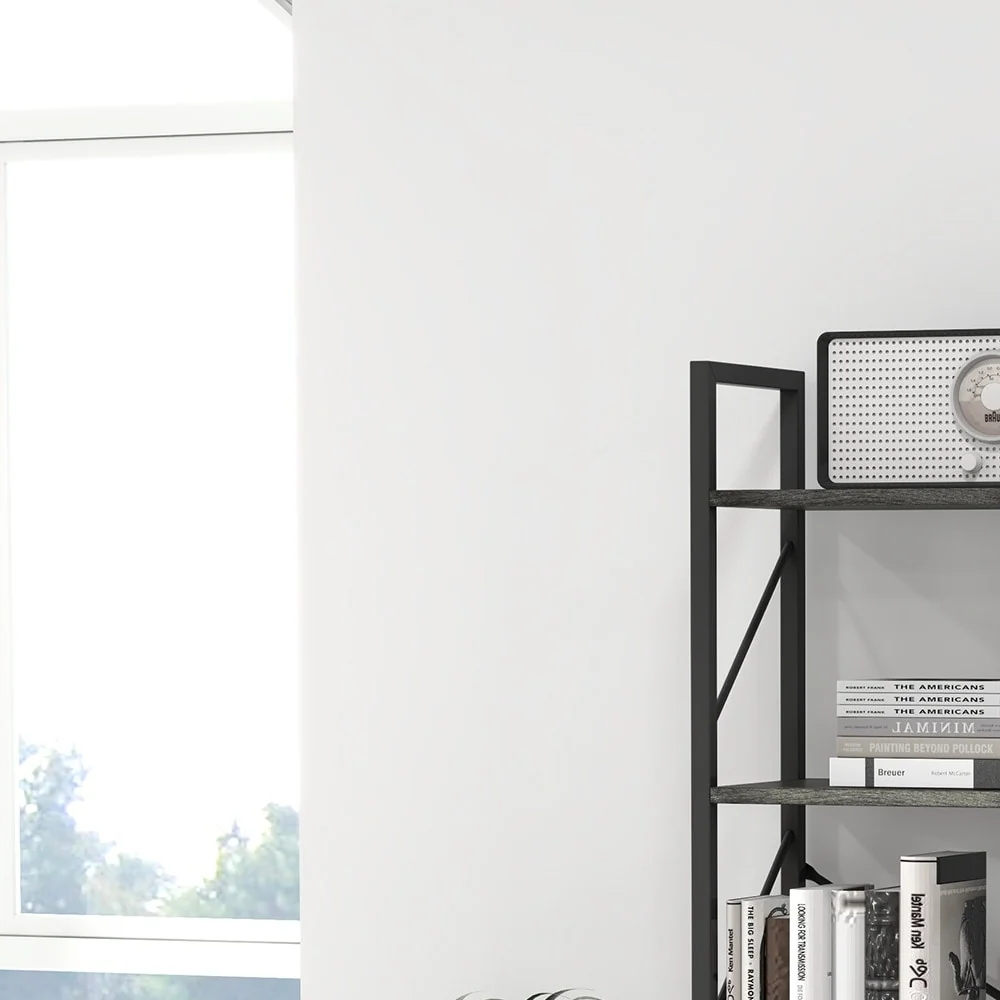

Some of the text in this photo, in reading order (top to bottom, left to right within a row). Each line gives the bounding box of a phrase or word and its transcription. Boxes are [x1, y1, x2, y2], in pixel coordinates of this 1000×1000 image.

[869, 742, 911, 753] PAINTING
[913, 743, 950, 753] BEYOND
[952, 743, 994, 754] POLLOCK
[877, 768, 906, 777] Breuer
[797, 903, 806, 981] LOOKING FOR TRANSMISSION
